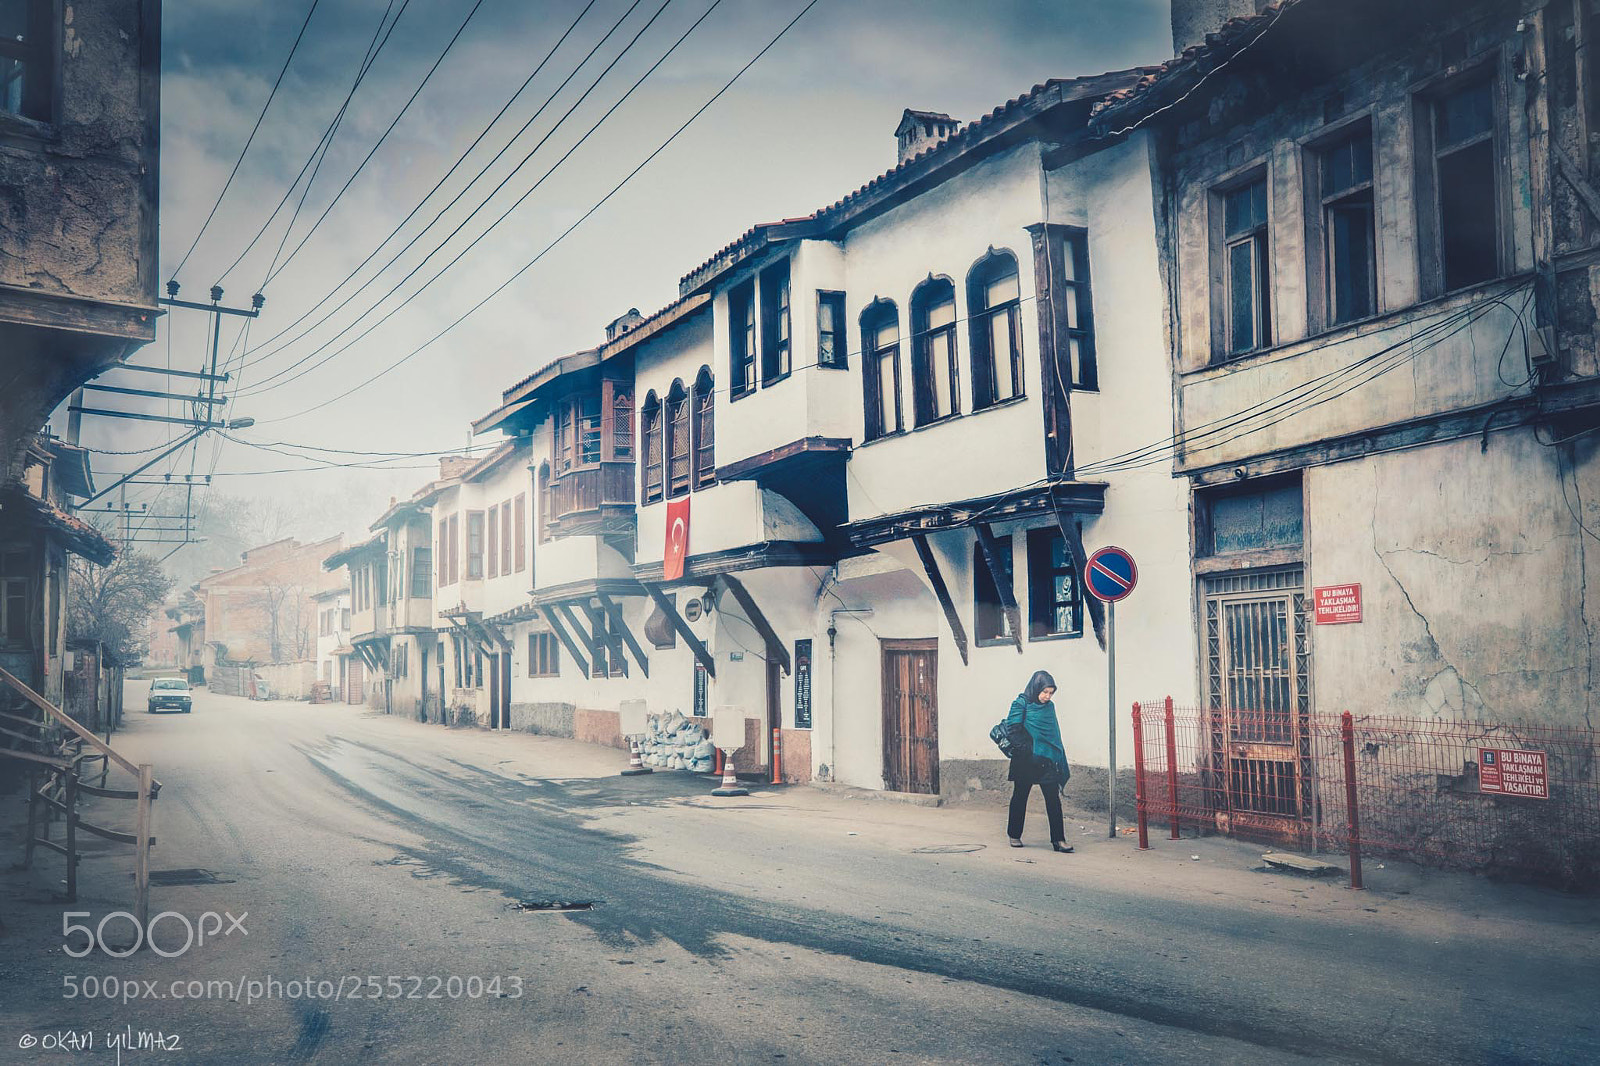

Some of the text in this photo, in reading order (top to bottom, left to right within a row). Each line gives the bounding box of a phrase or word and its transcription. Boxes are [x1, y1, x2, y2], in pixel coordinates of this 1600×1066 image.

[1501, 751, 1512, 762] BU
[1502, 763, 1543, 774] YAKLAŞMAK
[1503, 782, 1545, 795] YASAKTIR!
